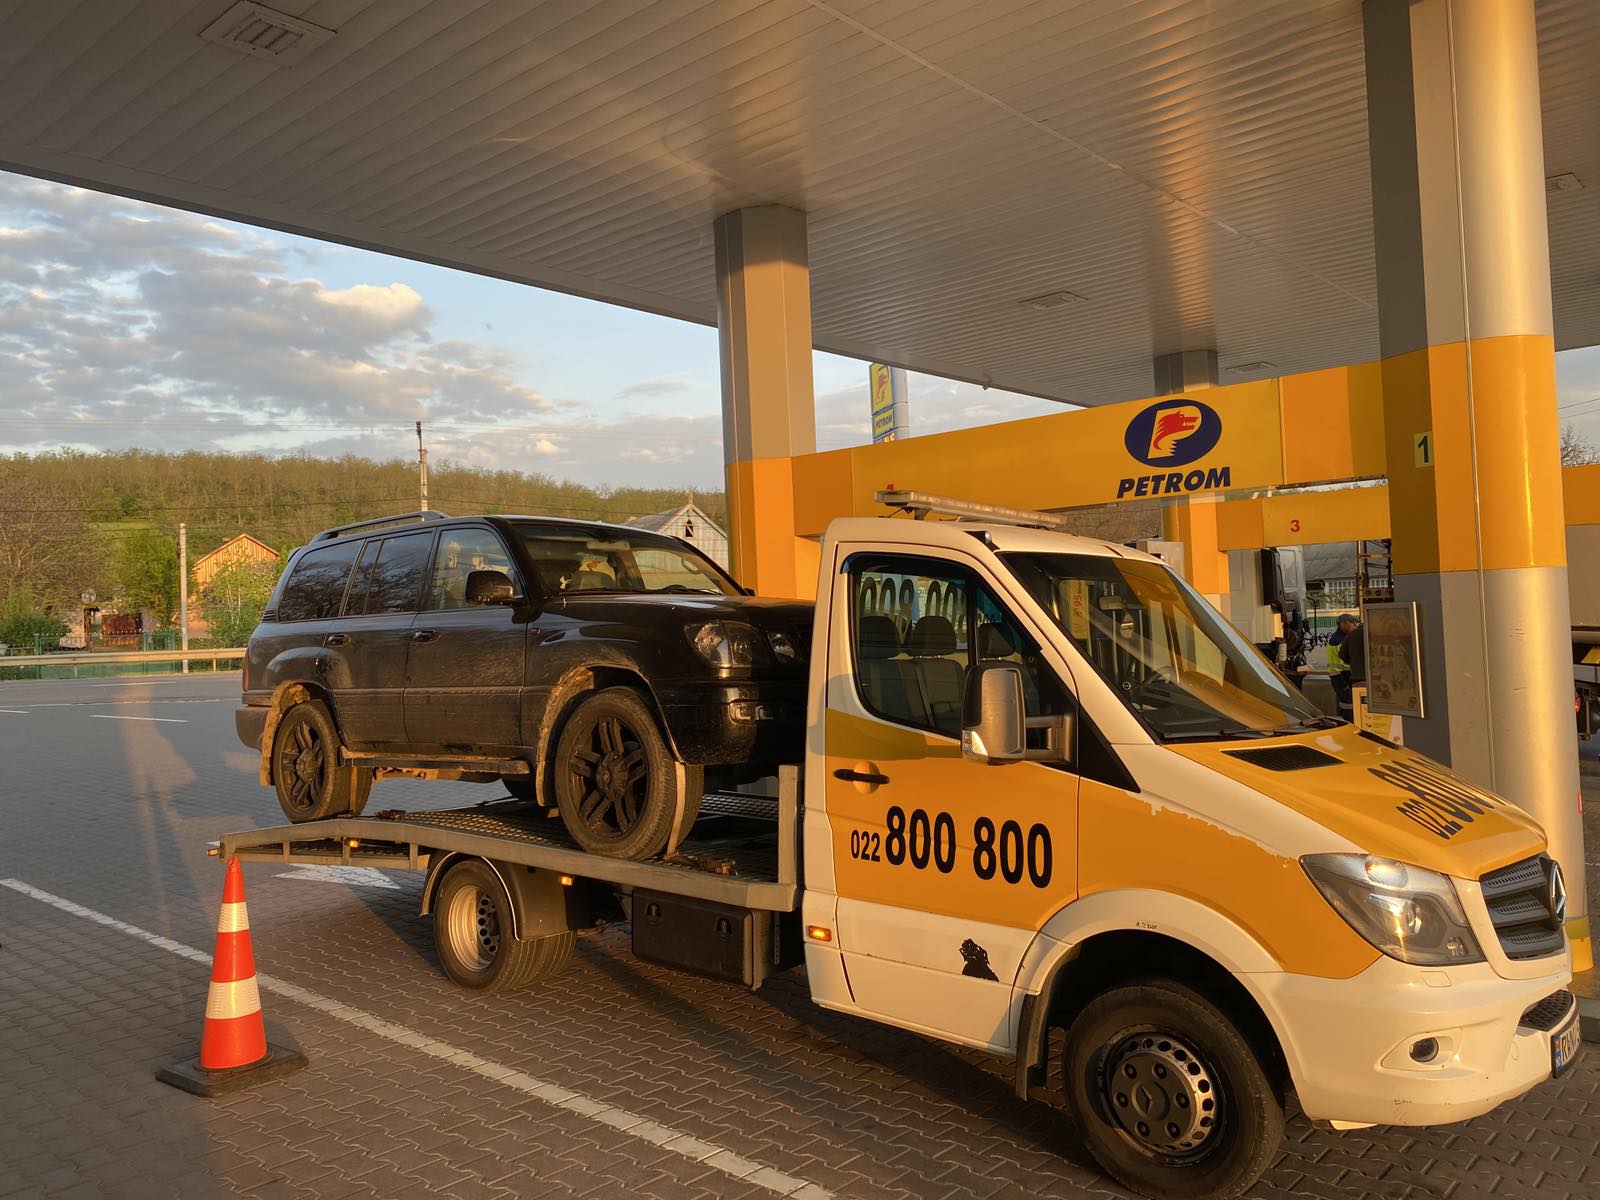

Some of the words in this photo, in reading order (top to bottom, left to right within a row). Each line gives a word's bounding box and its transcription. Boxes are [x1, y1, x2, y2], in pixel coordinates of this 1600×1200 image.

[1417, 435, 1429, 463] 1
[1117, 466, 1231, 499] PETROM
[1290, 519, 1300, 533] 3
[850, 829, 881, 863] 022
[885, 805, 957, 874] 800
[972, 816, 1053, 889] 800
